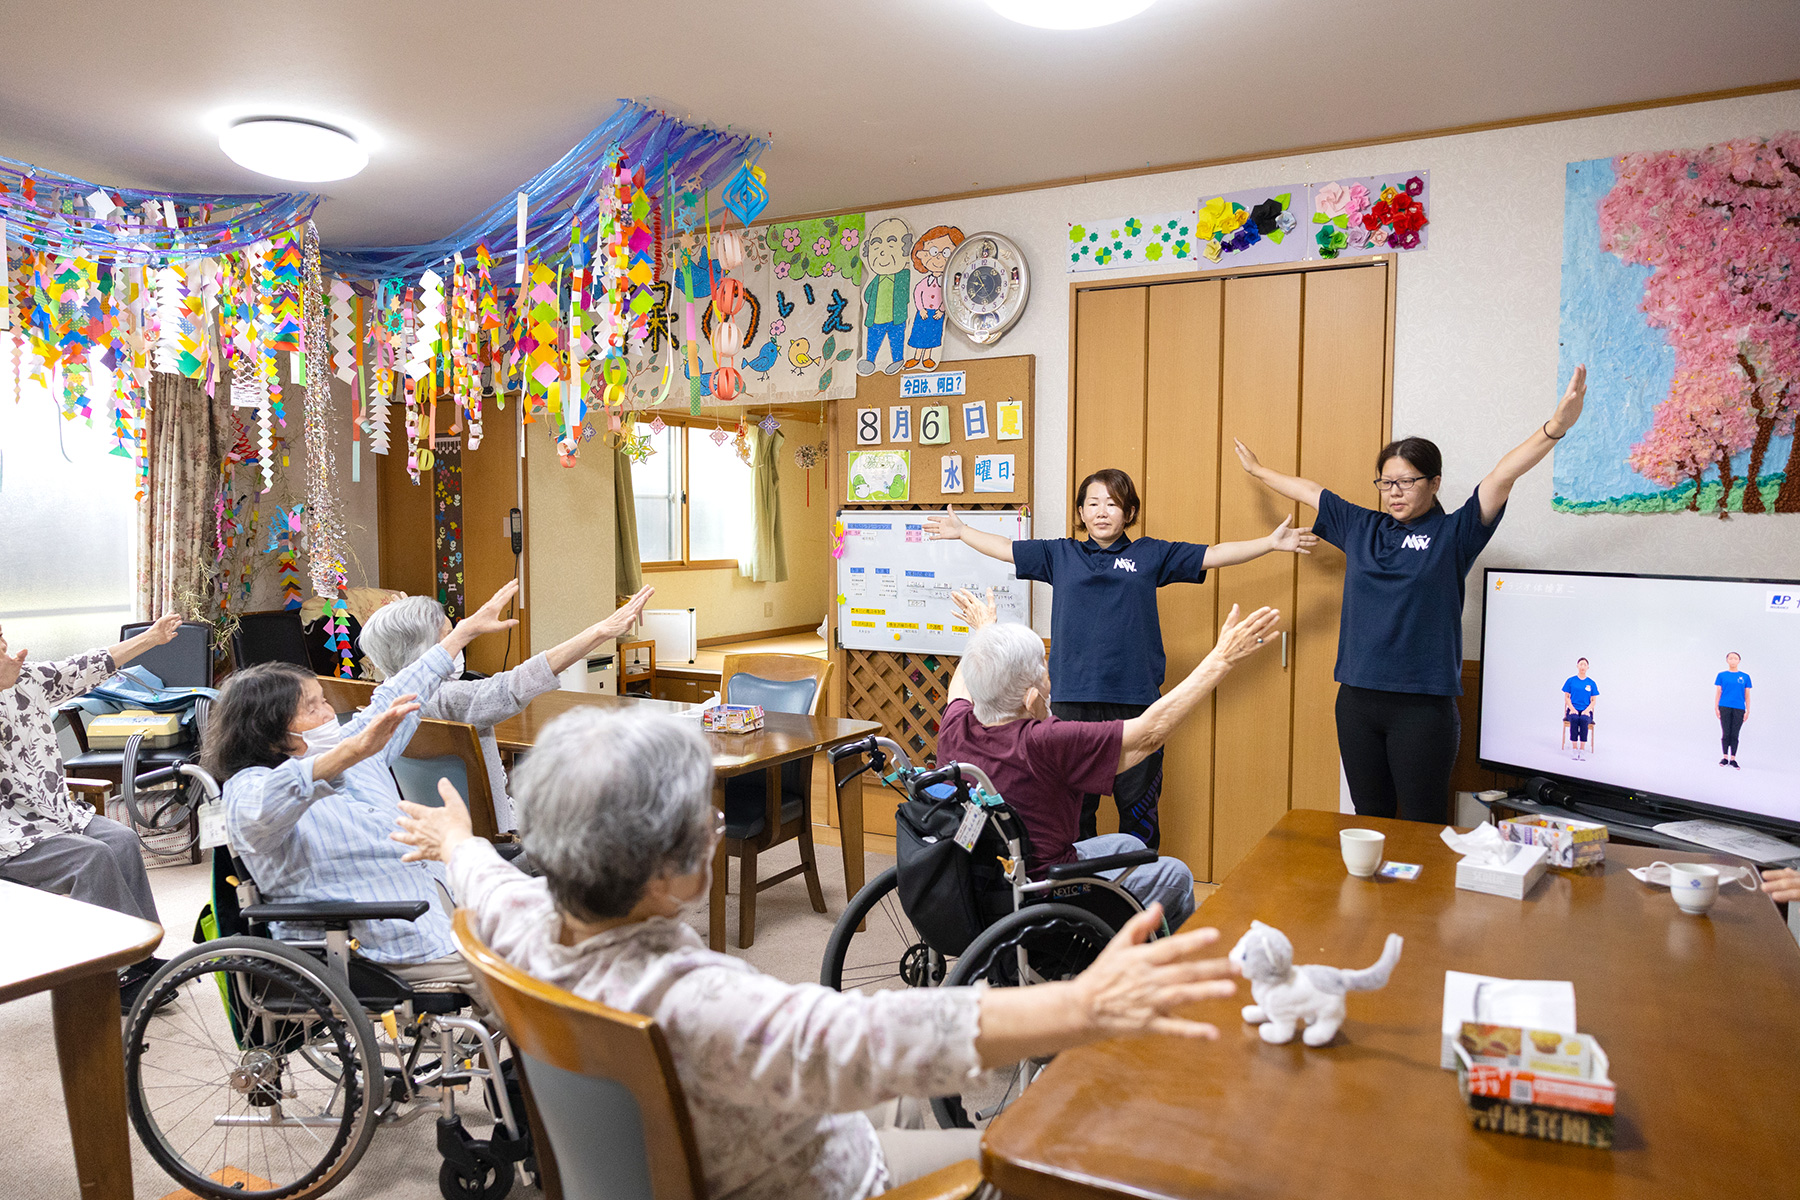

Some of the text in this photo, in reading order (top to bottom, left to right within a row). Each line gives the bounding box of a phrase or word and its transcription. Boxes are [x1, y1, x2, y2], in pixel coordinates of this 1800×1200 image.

[904, 376, 962, 395] 今日は、何日？
[859, 405, 986, 442] 8 月 6 日
[1000, 405, 1020, 436] 夏
[944, 459, 961, 490] 水
[975, 459, 1010, 482] 曜日
